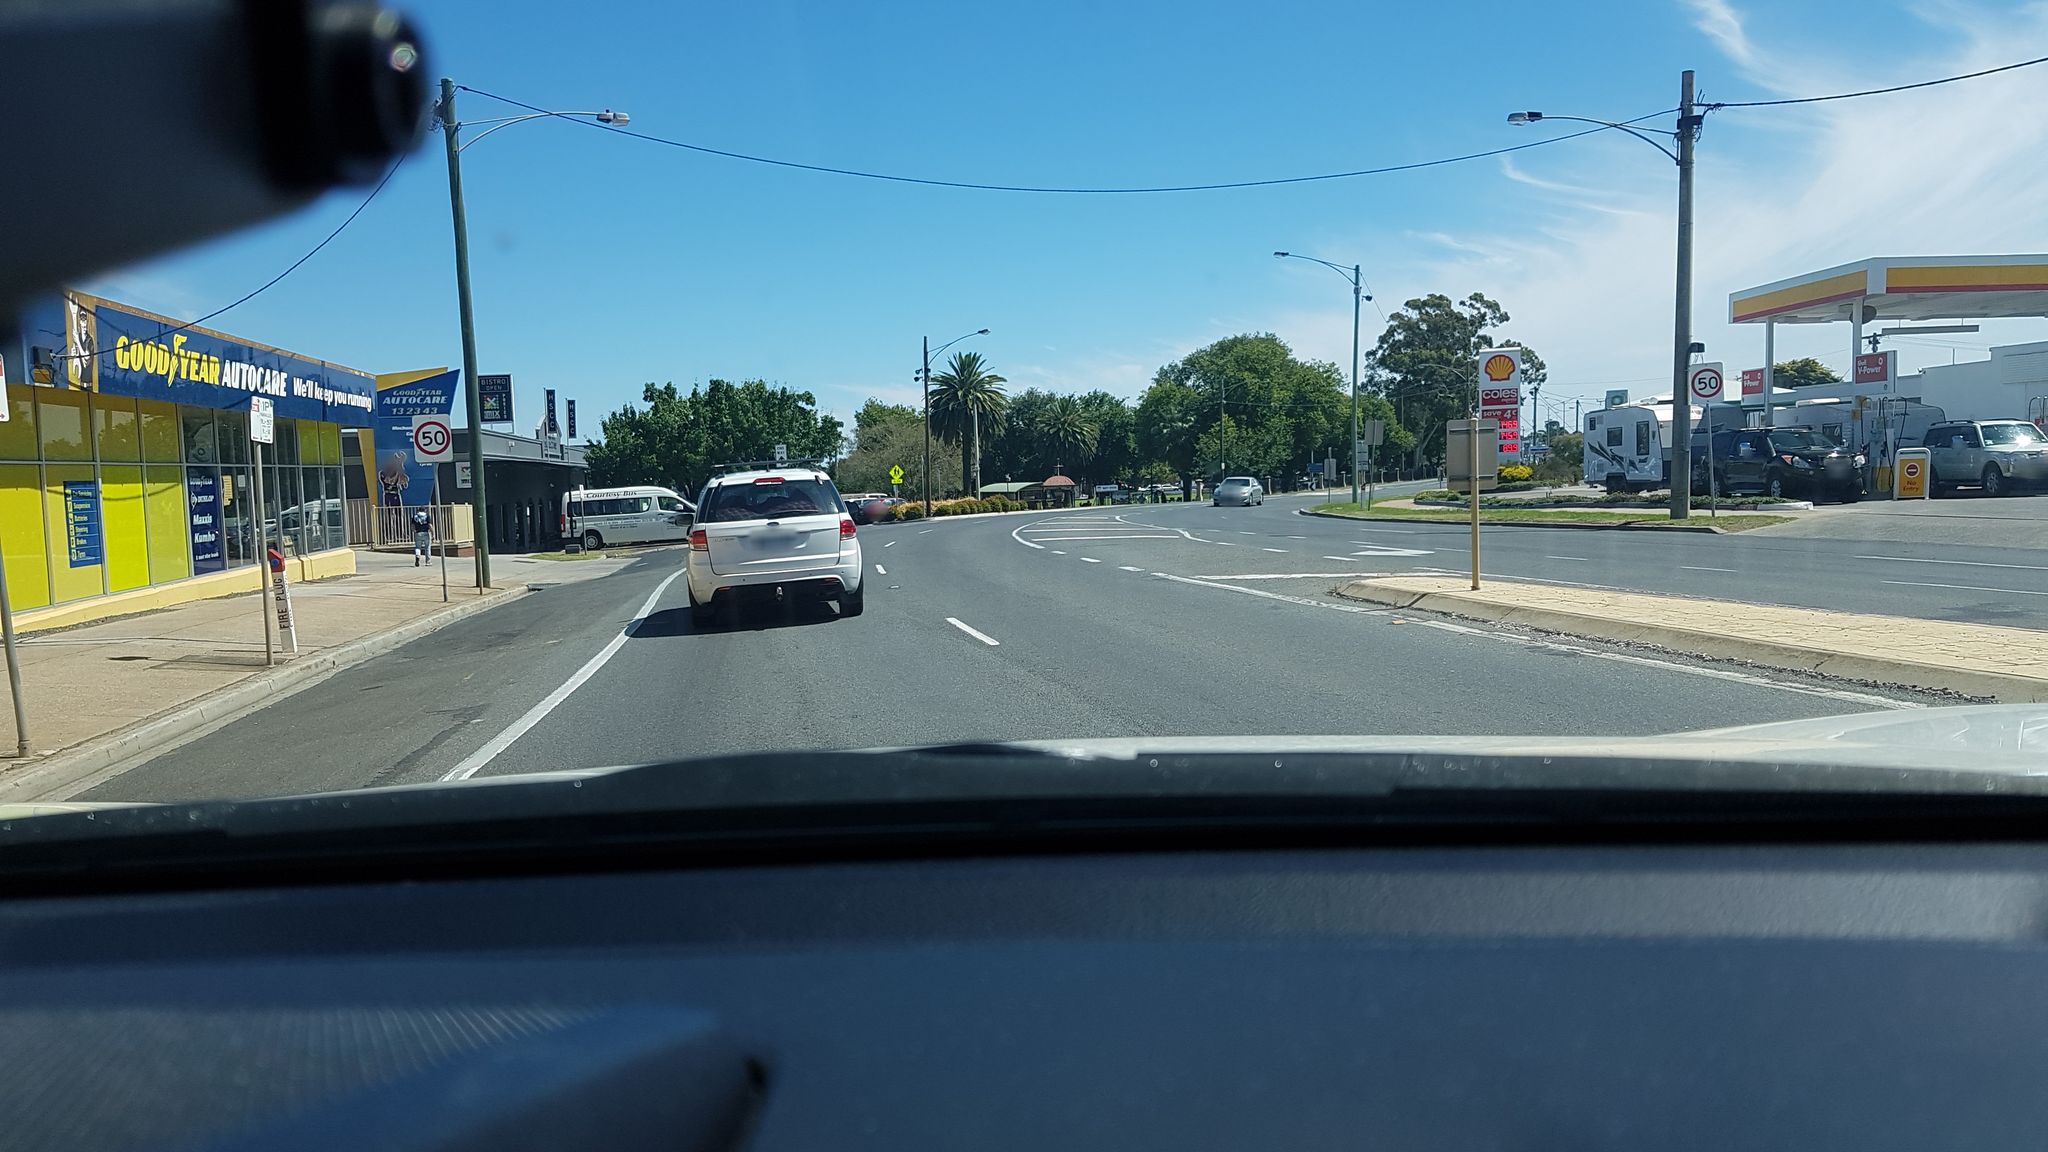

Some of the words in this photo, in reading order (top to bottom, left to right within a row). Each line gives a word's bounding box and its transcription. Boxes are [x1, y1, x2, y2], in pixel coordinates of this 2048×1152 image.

[115, 333, 220, 388] GOODYEAR
[1857, 366, 1881, 374] V-Power
[221, 360, 288, 397] AUTOCARE
[1697, 376, 1719, 391] 50
[293, 377, 314, 399] We'll
[314, 382, 333, 406] keep
[334, 390, 348, 407] you
[347, 392, 372, 413] running
[392, 388, 443, 397] GOODYEAR
[1482, 388, 1518, 399] coles
[382, 396, 448, 405] AUTOCARE
[392, 407, 404, 415] 13
[406, 407, 421, 415] 23
[423, 407, 438, 415] 43
[422, 430, 446, 447] 50
[586, 491, 620, 499] Courtesy
[193, 513, 213, 525] Maxxis
[194, 531, 215, 543] Kumho
[273, 578, 286, 601] PLUG
[277, 607, 289, 630] FIRE
